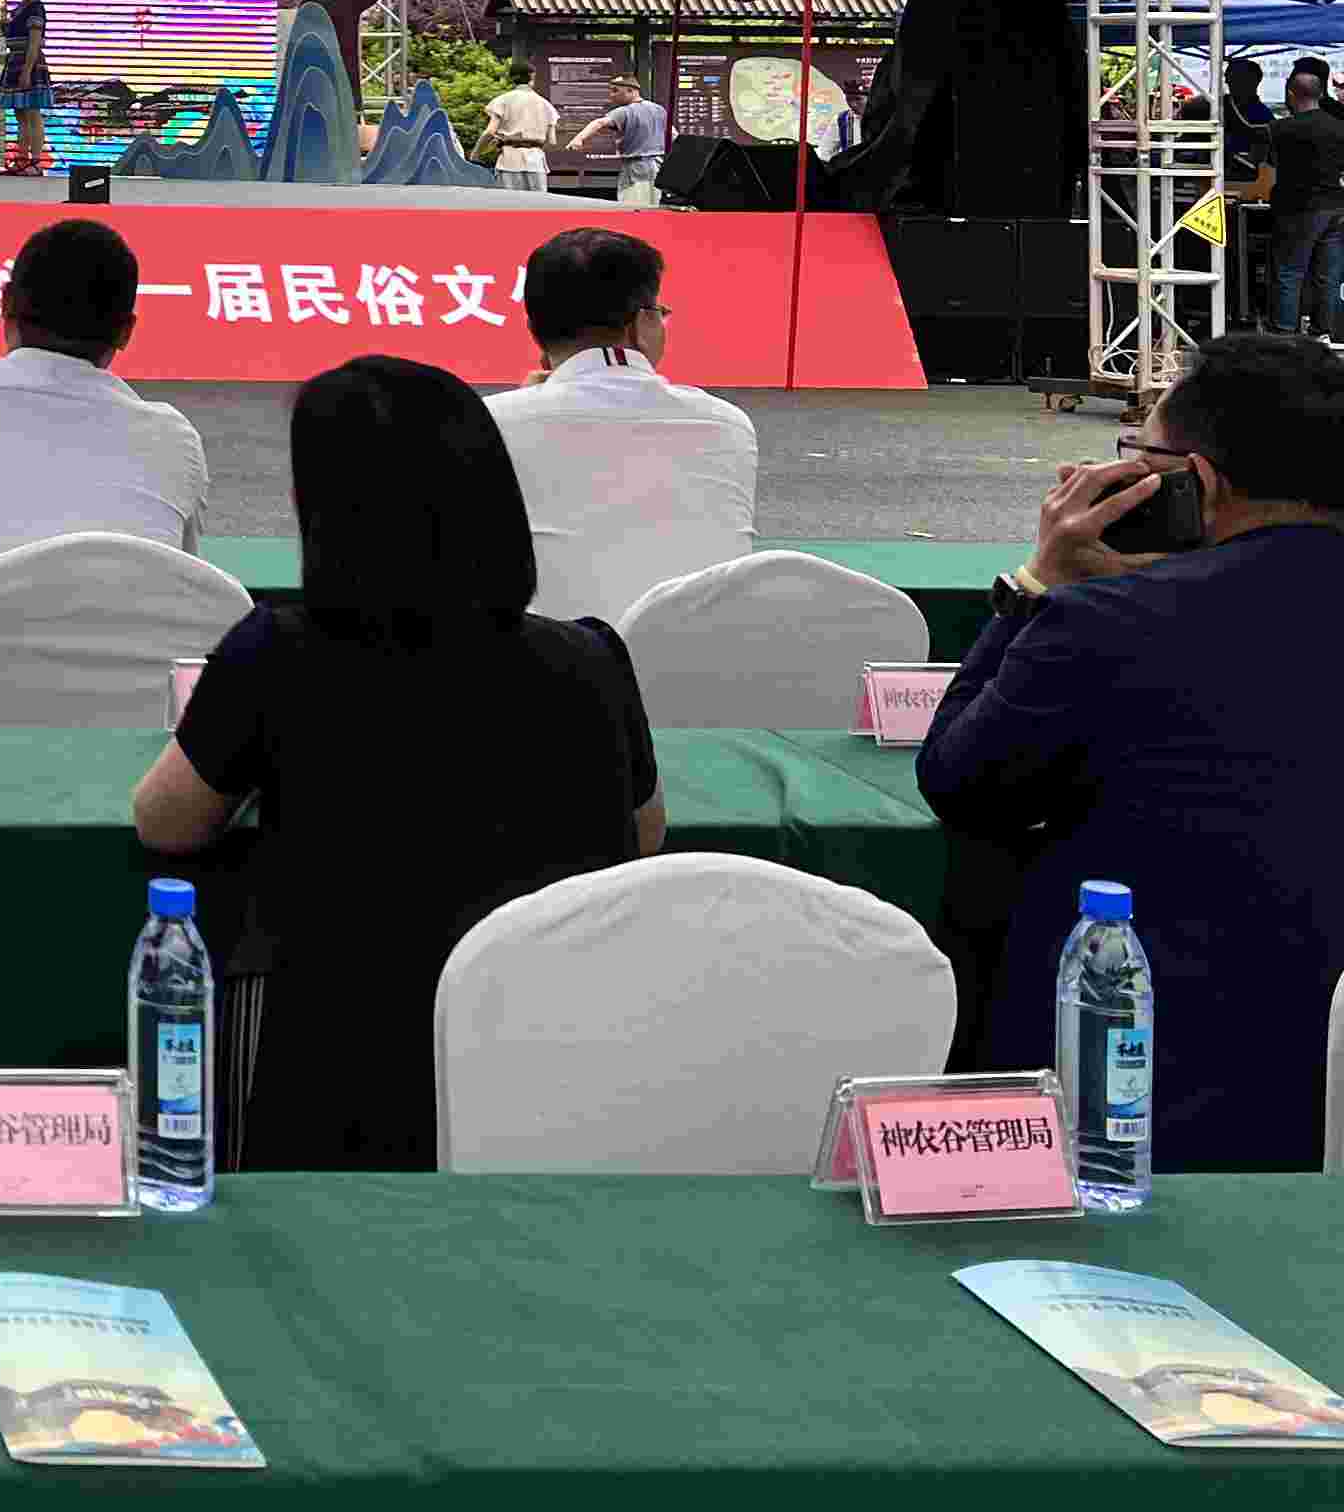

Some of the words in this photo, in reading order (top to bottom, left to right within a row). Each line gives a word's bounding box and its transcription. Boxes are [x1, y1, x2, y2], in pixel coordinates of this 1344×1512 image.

[878, 1116, 1054, 1157] 神农谷管理局
